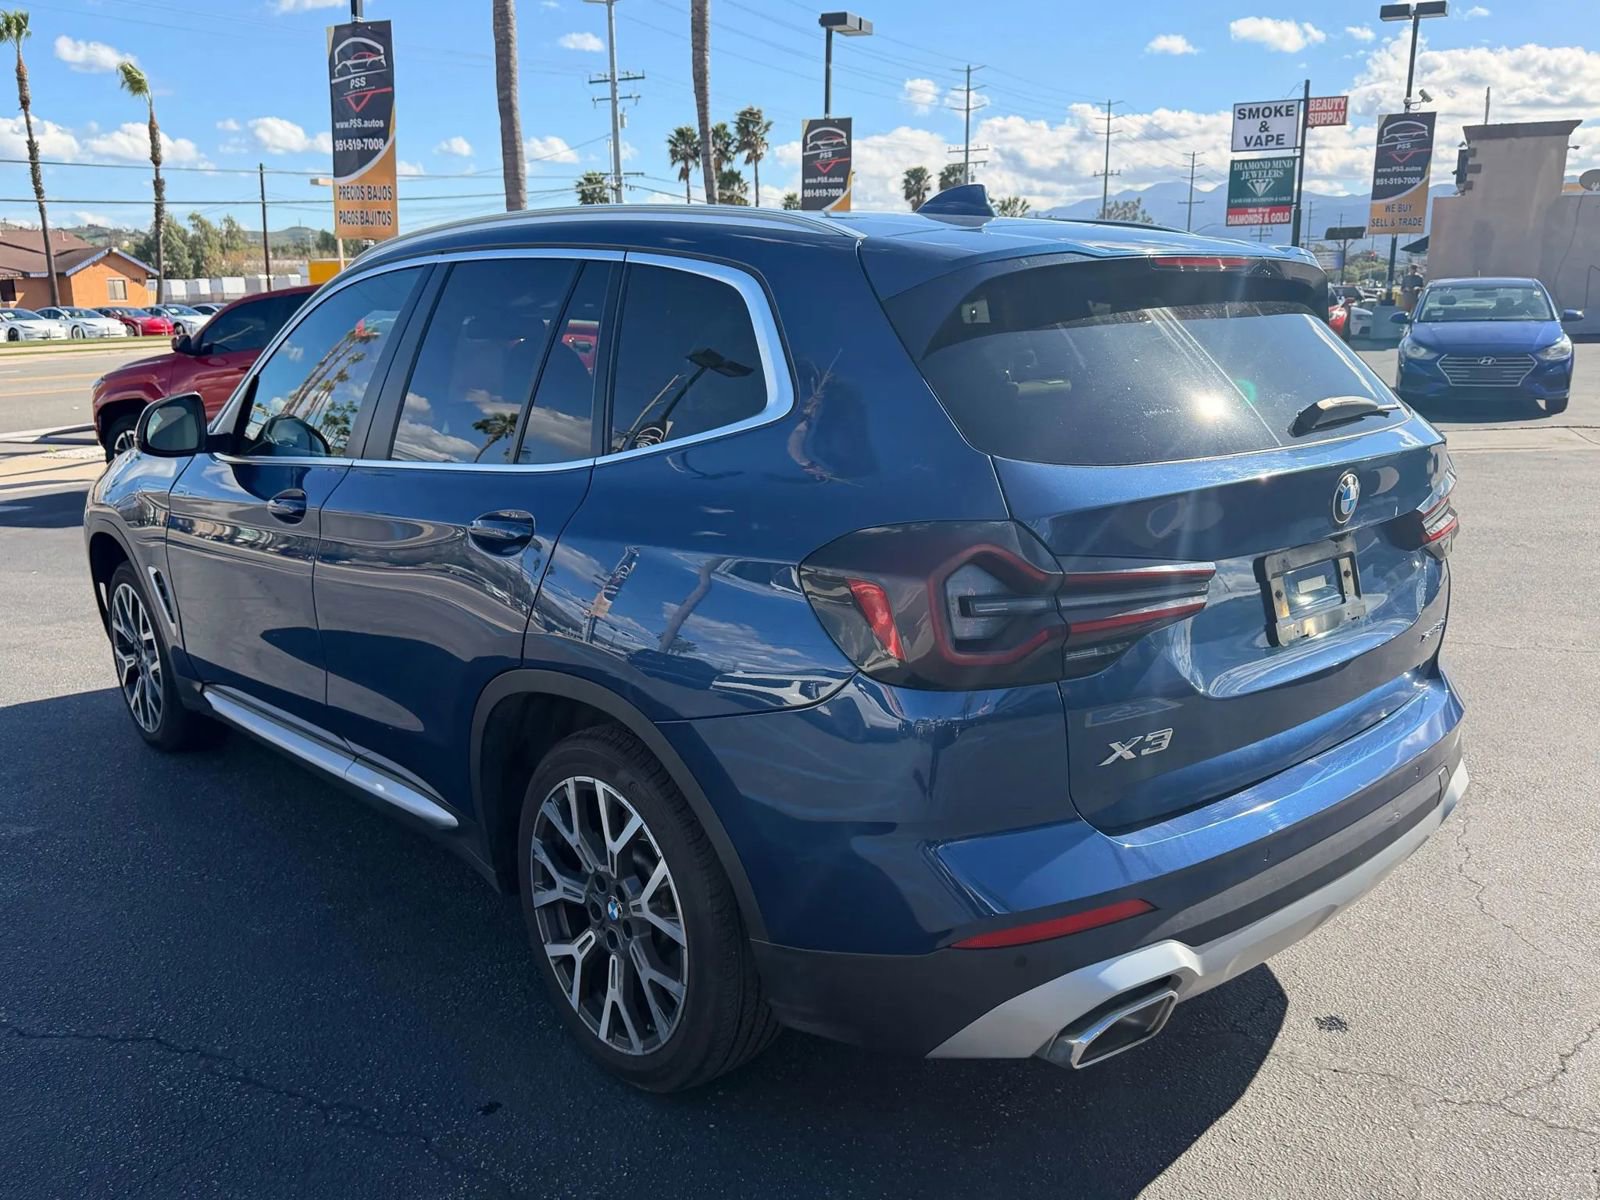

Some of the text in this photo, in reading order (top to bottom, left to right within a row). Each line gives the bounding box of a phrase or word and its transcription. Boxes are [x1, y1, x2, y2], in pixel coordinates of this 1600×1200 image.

[350, 77, 366, 89] PSS
[1309, 97, 1346, 111] BEAUTY
[1237, 104, 1295, 120] SMOKE
[1308, 110, 1345, 125] SUPPLY
[335, 118, 384, 129] www.PSS.autos
[1258, 120, 1270, 133] &
[335, 137, 384, 151] 951-519-7008
[1243, 133, 1285, 148] VAPE
[1233, 158, 1293, 171] DIAMOND MIND
[1240, 169, 1284, 180] JEWELERS
[338, 185, 392, 200] PRECIOS BAJOS
[1385, 203, 1412, 213] WE BUY
[338, 210, 392, 226] PAGOS BAJITOS
[1227, 213, 1263, 225] DIAMONDS
[1270, 211, 1290, 223] GOLD
[1371, 218, 1388, 227] SELL
[1398, 217, 1423, 226] TRADE
[1096, 727, 1173, 767] X3
